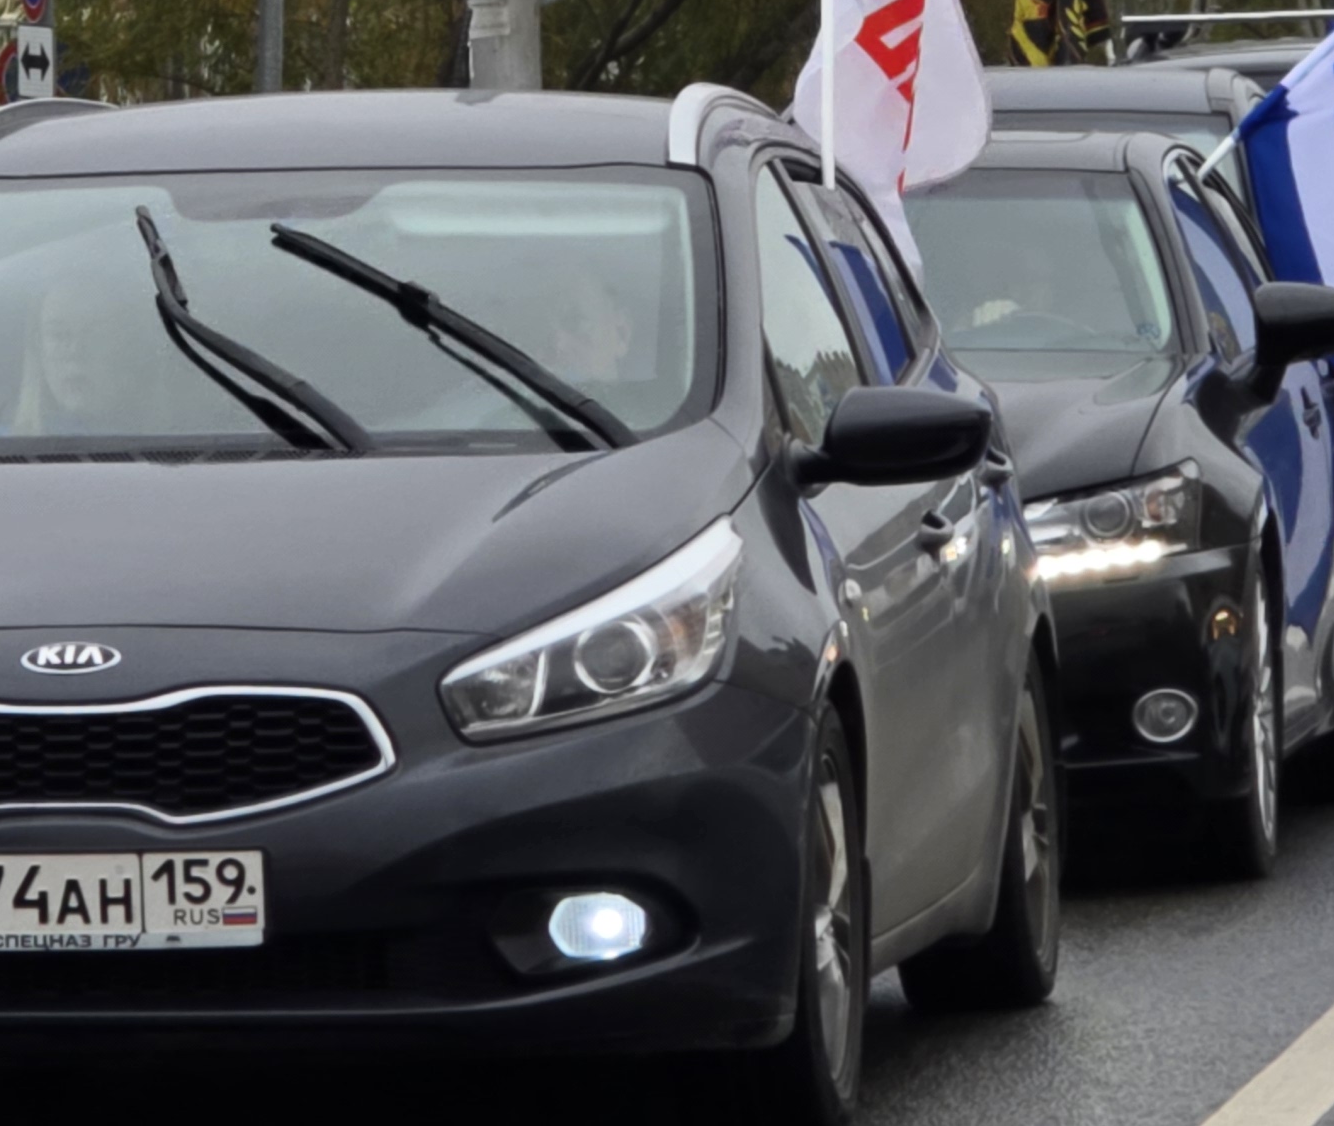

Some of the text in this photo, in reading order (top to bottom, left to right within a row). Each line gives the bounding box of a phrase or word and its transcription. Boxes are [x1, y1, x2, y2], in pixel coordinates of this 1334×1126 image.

[36, 643, 104, 667] KIA
[150, 858, 247, 906] 159
[172, 909, 221, 926] RUS
[103, 932, 142, 949] ГРУ
